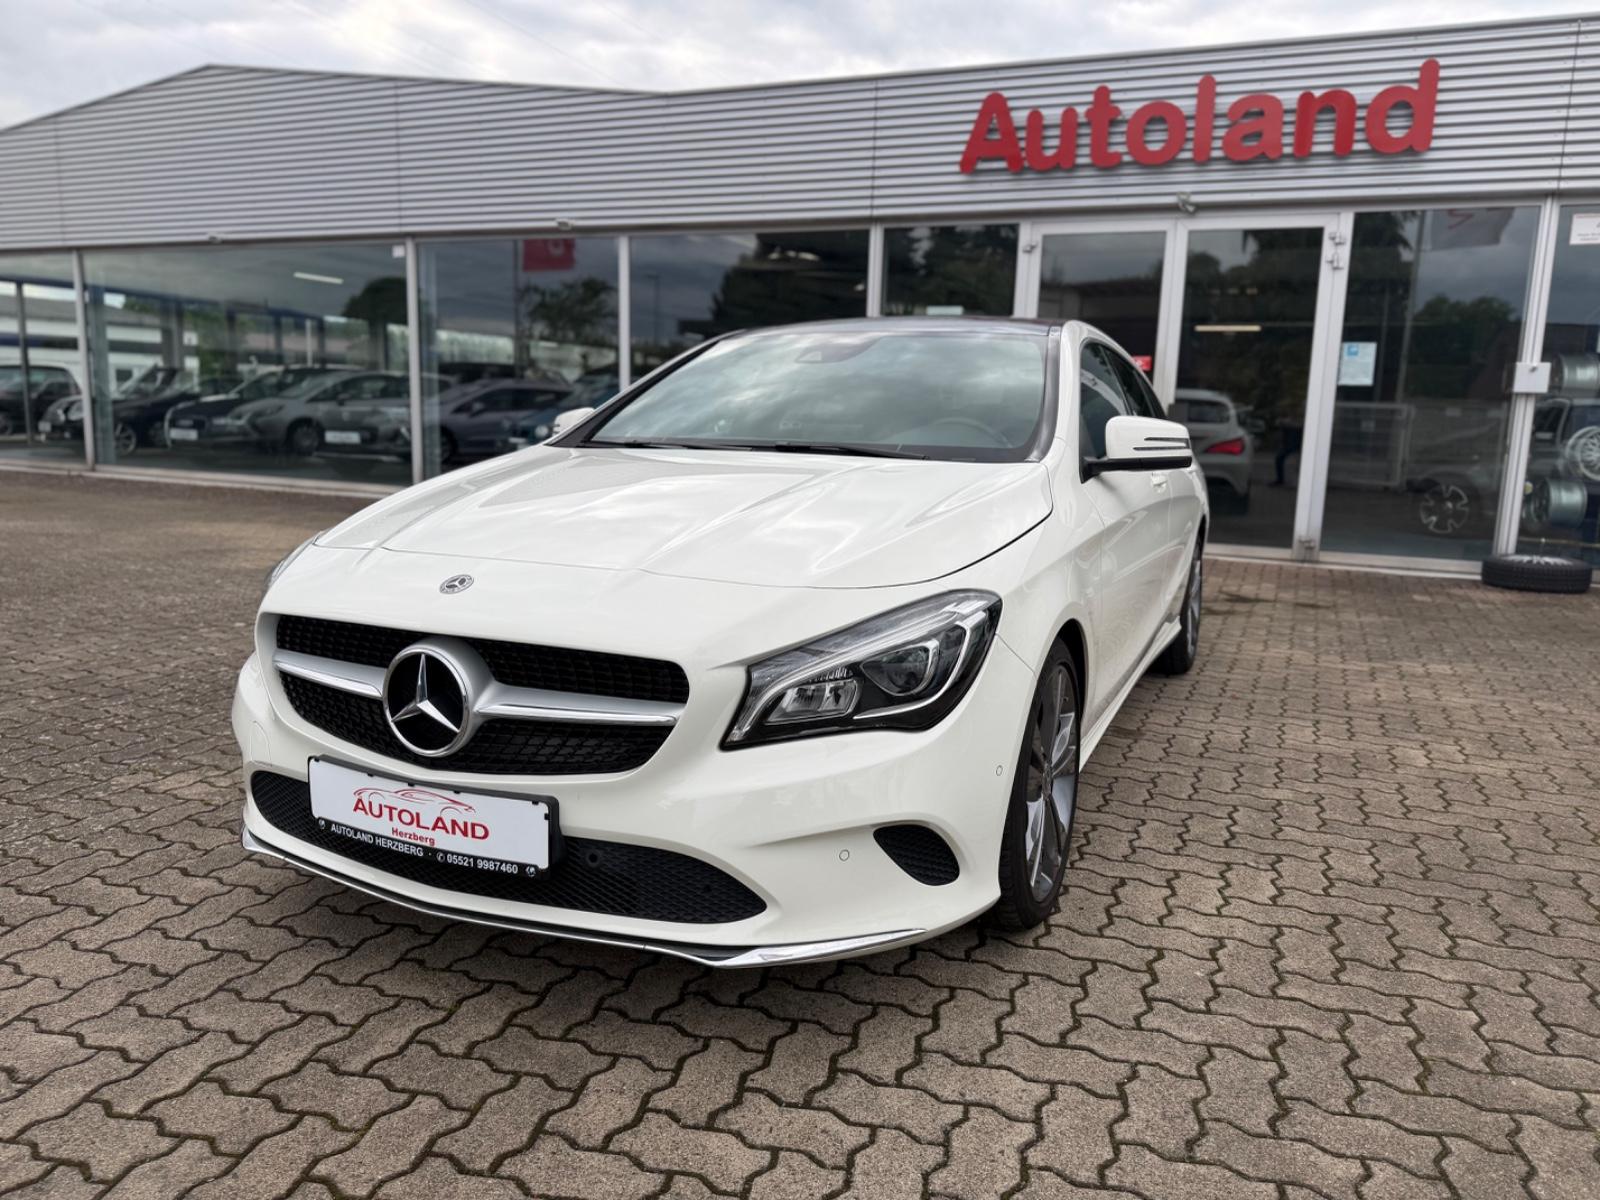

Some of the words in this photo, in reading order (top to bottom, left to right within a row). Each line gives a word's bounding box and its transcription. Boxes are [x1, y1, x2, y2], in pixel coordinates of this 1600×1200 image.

[960, 57, 1440, 174] Autoland
[353, 798, 489, 840] AUTOLAND
[391, 827, 435, 847] Herzberg
[331, 823, 374, 843] AUTOLAND
[375, 836, 424, 857] HERZBERG
[446, 853, 474, 867] 05521
[477, 859, 518, 874] 9987460
